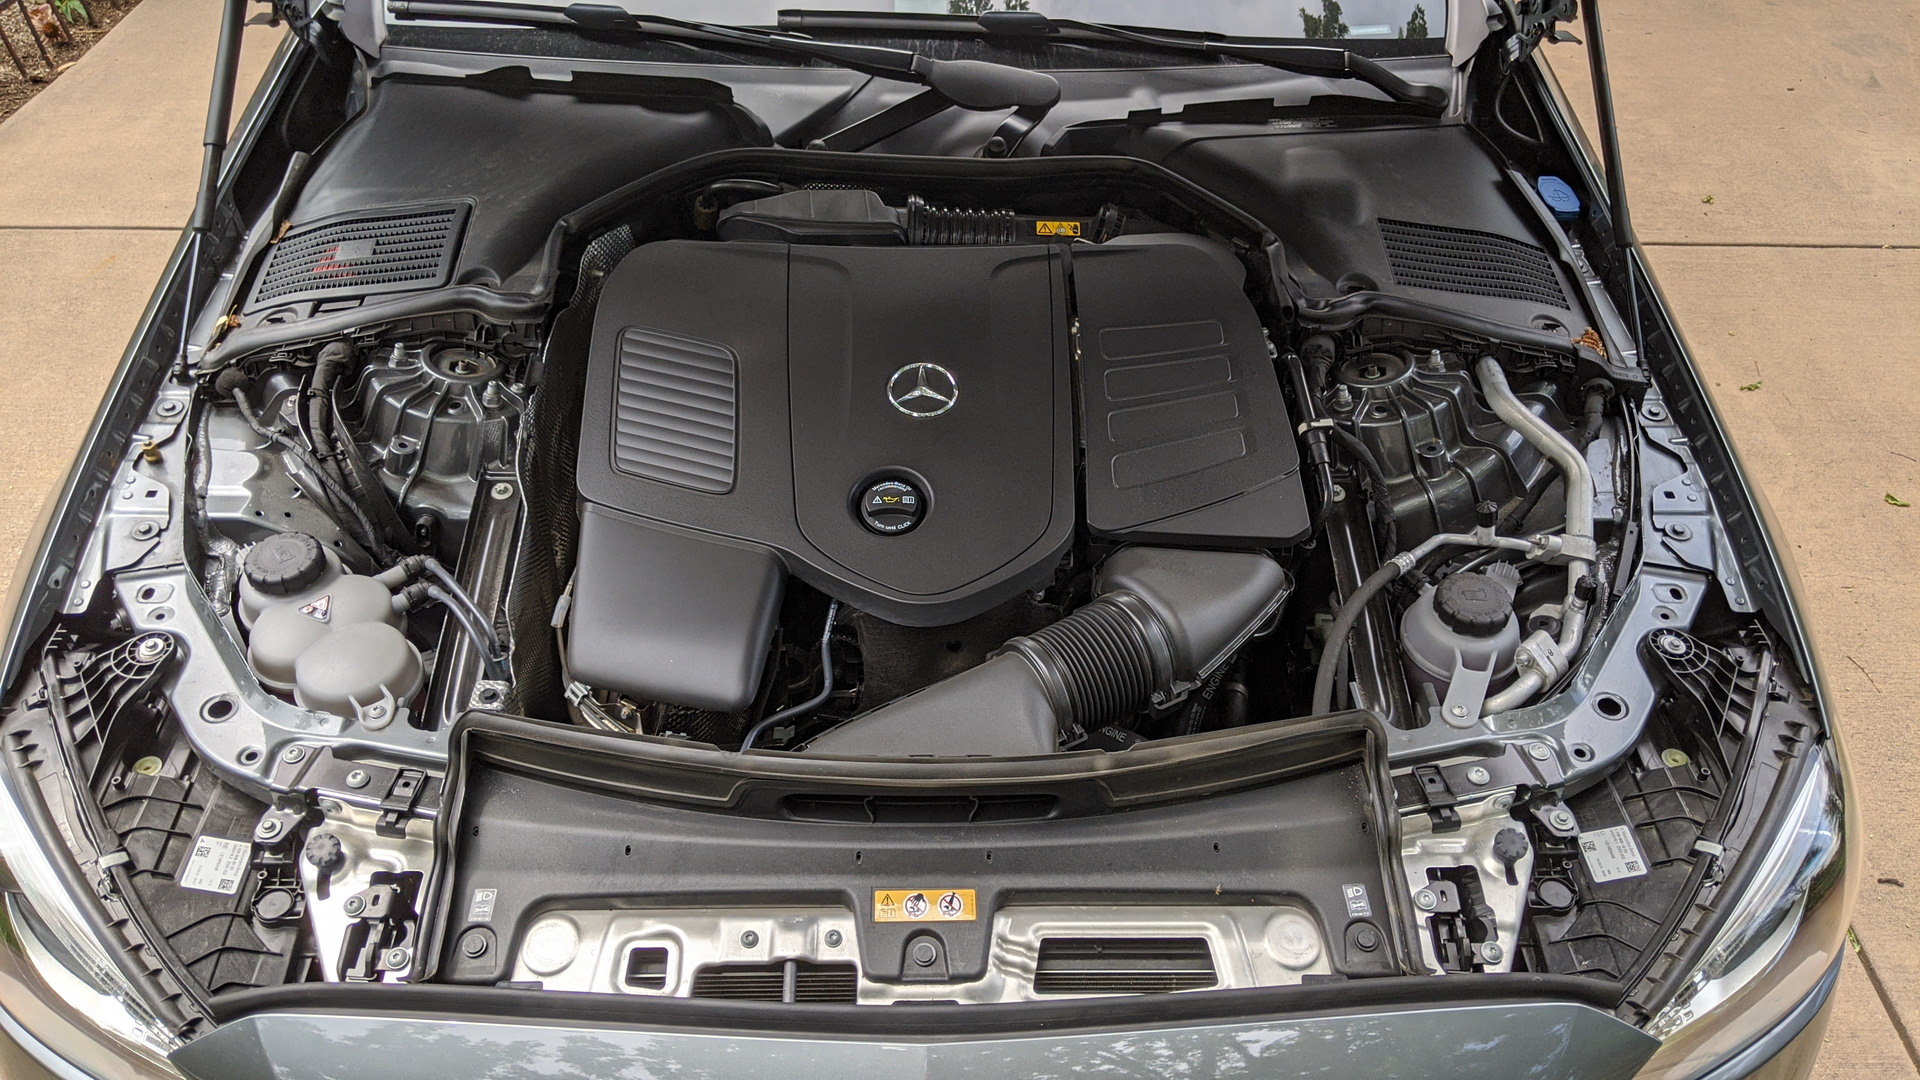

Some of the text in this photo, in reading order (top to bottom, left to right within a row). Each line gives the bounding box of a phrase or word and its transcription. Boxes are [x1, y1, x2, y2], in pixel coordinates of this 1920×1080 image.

[898, 521, 912, 529] CLICK
[1202, 664, 1230, 700] ENGINE
[1102, 726, 1127, 742] NGINE
